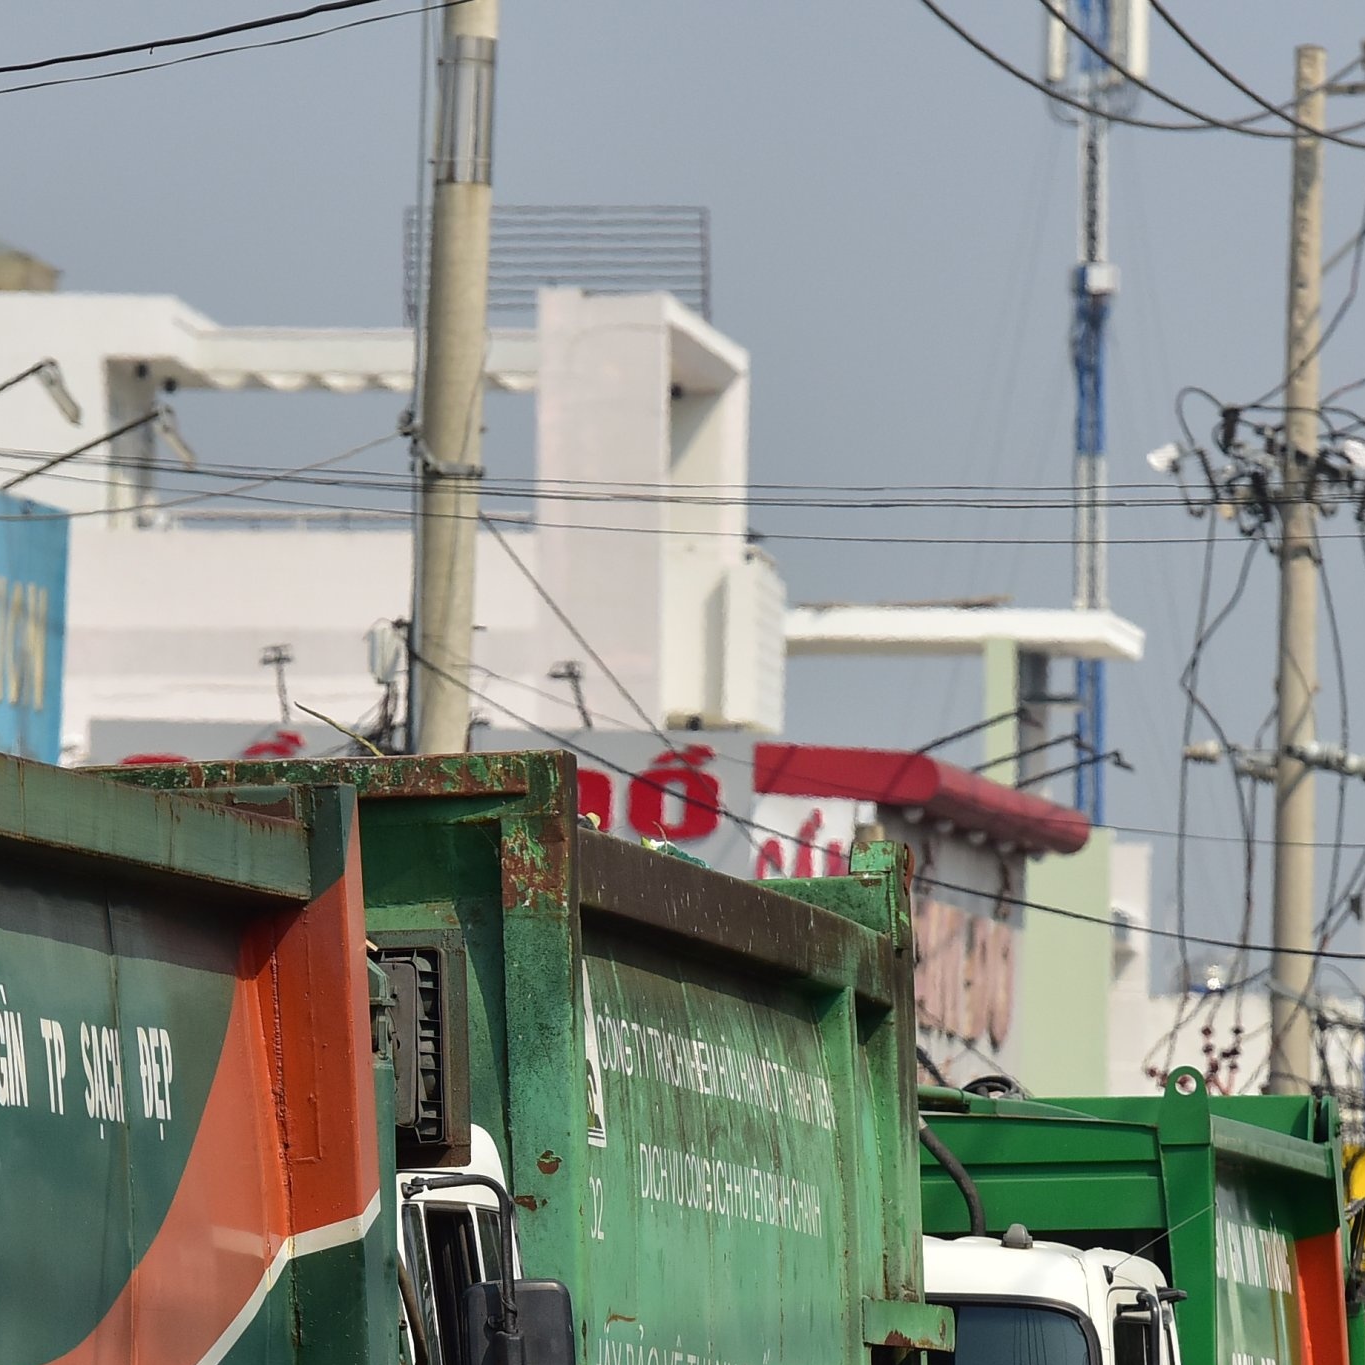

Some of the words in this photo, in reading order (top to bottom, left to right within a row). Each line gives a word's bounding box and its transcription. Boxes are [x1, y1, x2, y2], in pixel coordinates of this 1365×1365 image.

[596, 1003, 633, 1077] CÔNG
[631, 1023, 650, 1078] TY
[40, 1018, 68, 1115] TP
[79, 1021, 126, 1140] SẠCH
[135, 1026, 174, 1141] ĐẸP
[639, 1142, 668, 1213] DỊCH
[666, 1149, 684, 1219] VỤ
[684, 1142, 712, 1212] CÔNG
